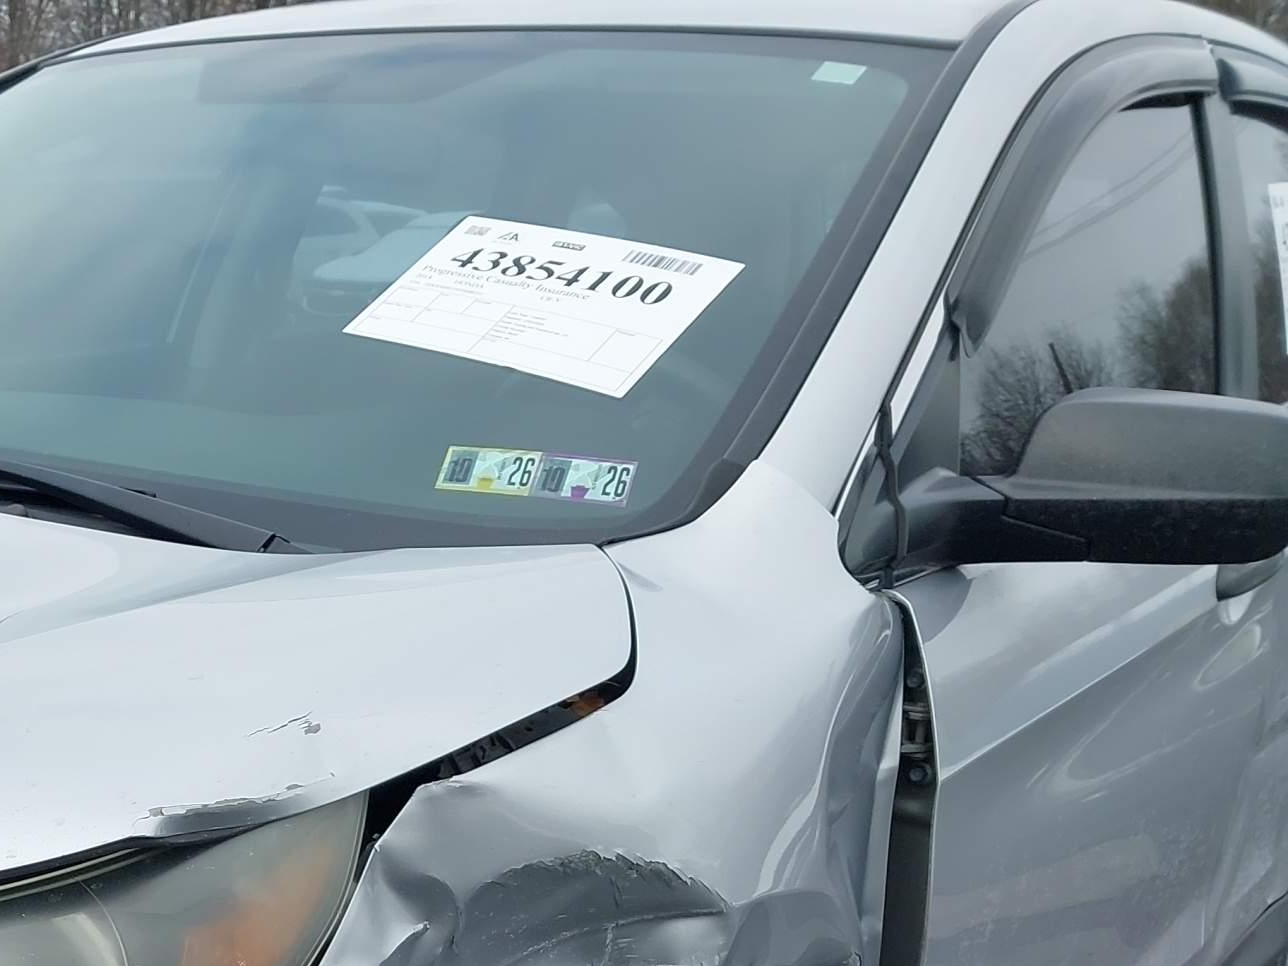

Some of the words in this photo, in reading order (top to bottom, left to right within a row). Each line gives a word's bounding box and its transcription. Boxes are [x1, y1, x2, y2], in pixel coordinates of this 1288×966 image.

[423, 265, 484, 281] Progressive
[535, 284, 591, 300] Insurance
[451, 247, 673, 306] 43854100
[507, 456, 536, 487] 26
[601, 466, 631, 498] 26
